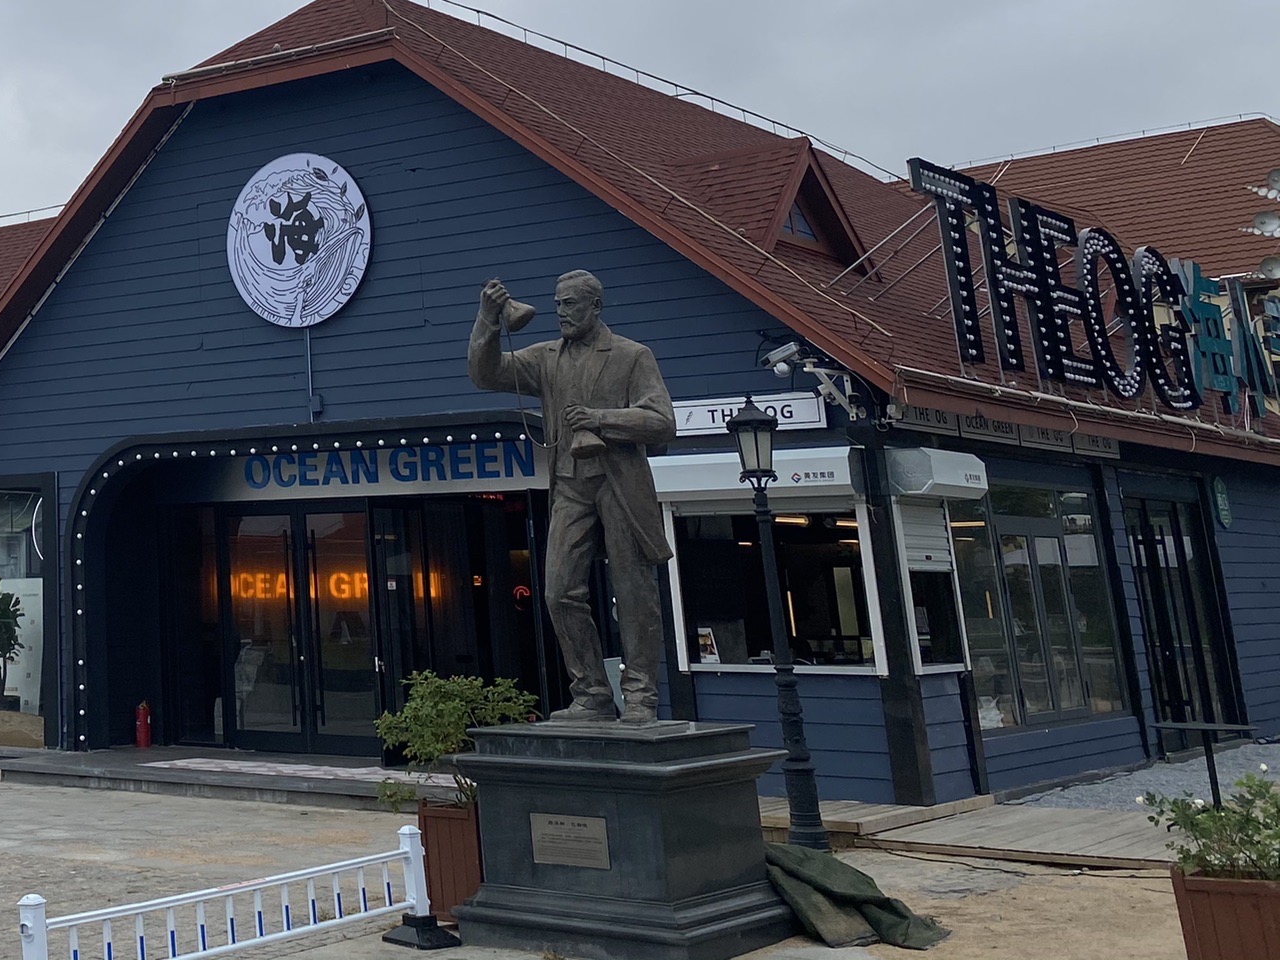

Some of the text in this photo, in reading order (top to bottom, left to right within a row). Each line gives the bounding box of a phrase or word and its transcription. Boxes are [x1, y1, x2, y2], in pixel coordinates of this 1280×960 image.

[1169, 257, 1280, 417] 海小
[764, 404, 794, 420] OG
[913, 406, 948, 424] THE OG
[965, 415, 1014, 435] OCEAN GREEN
[244, 440, 537, 489] OCEAN GREEN
